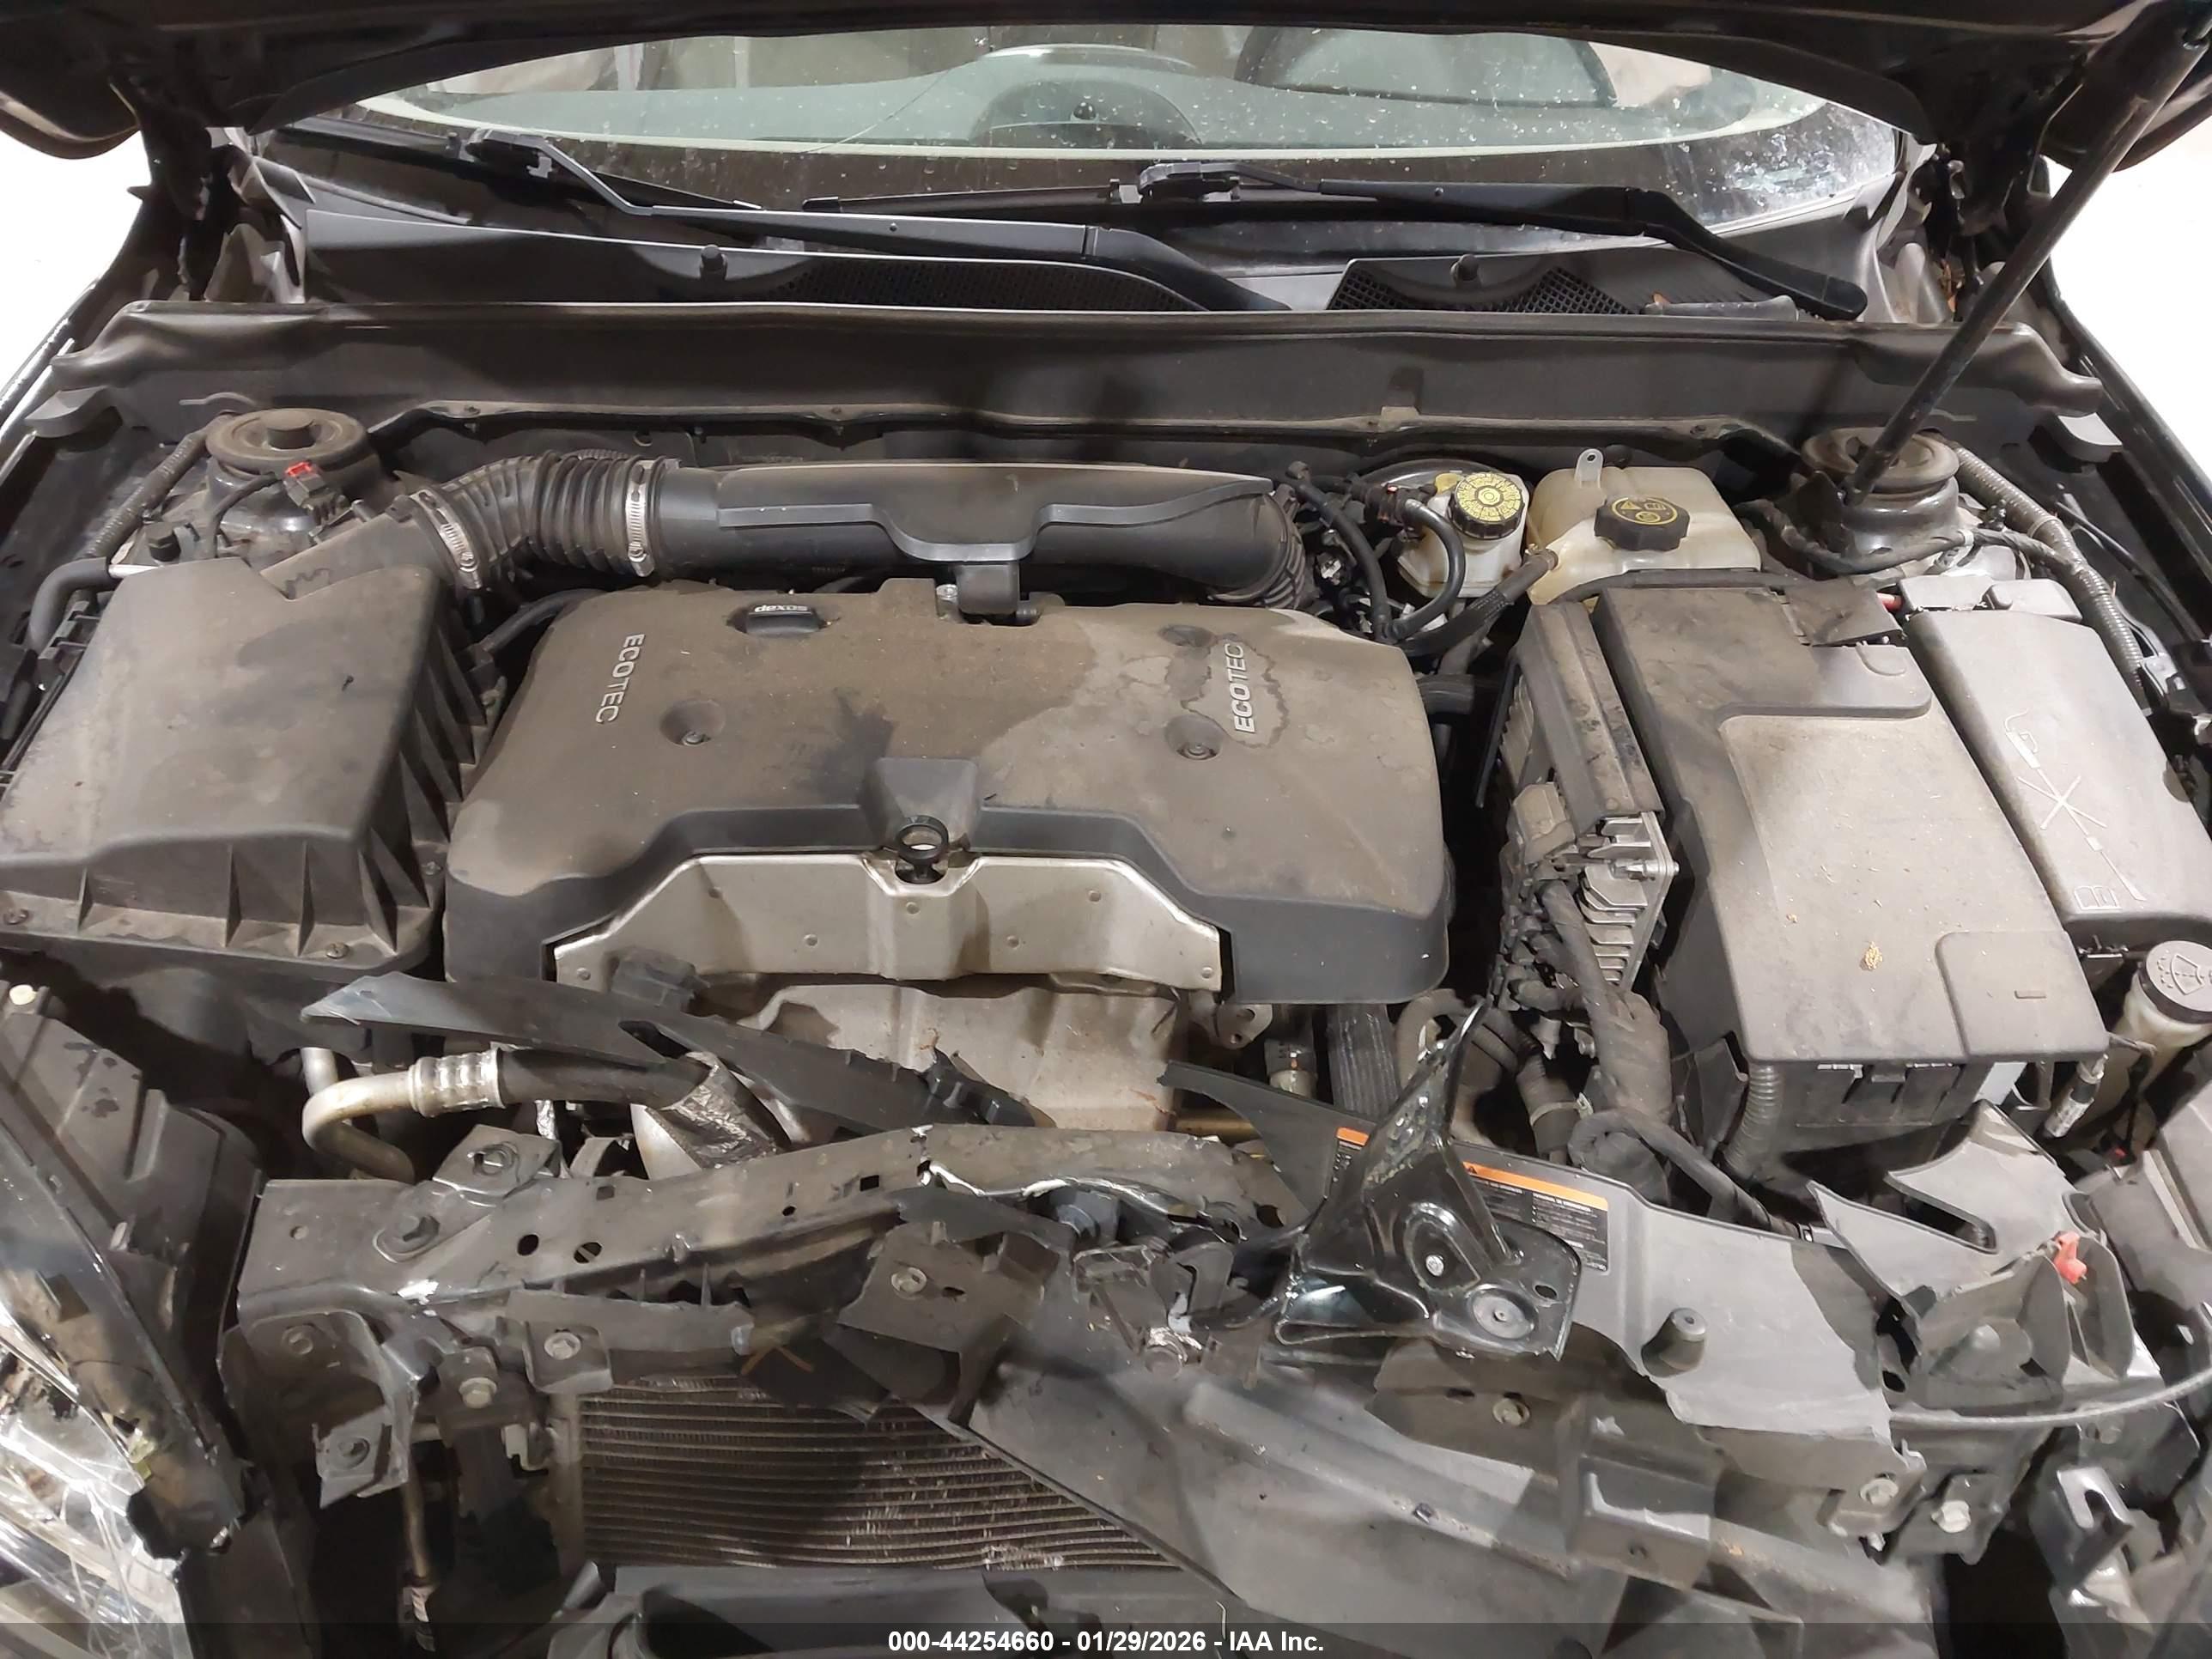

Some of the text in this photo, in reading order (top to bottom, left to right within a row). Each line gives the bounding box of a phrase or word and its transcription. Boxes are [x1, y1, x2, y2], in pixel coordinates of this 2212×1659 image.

[754, 604, 808, 613] dexos
[595, 634, 645, 723] ECOTEC
[1224, 643, 1255, 734] ECOTEC
